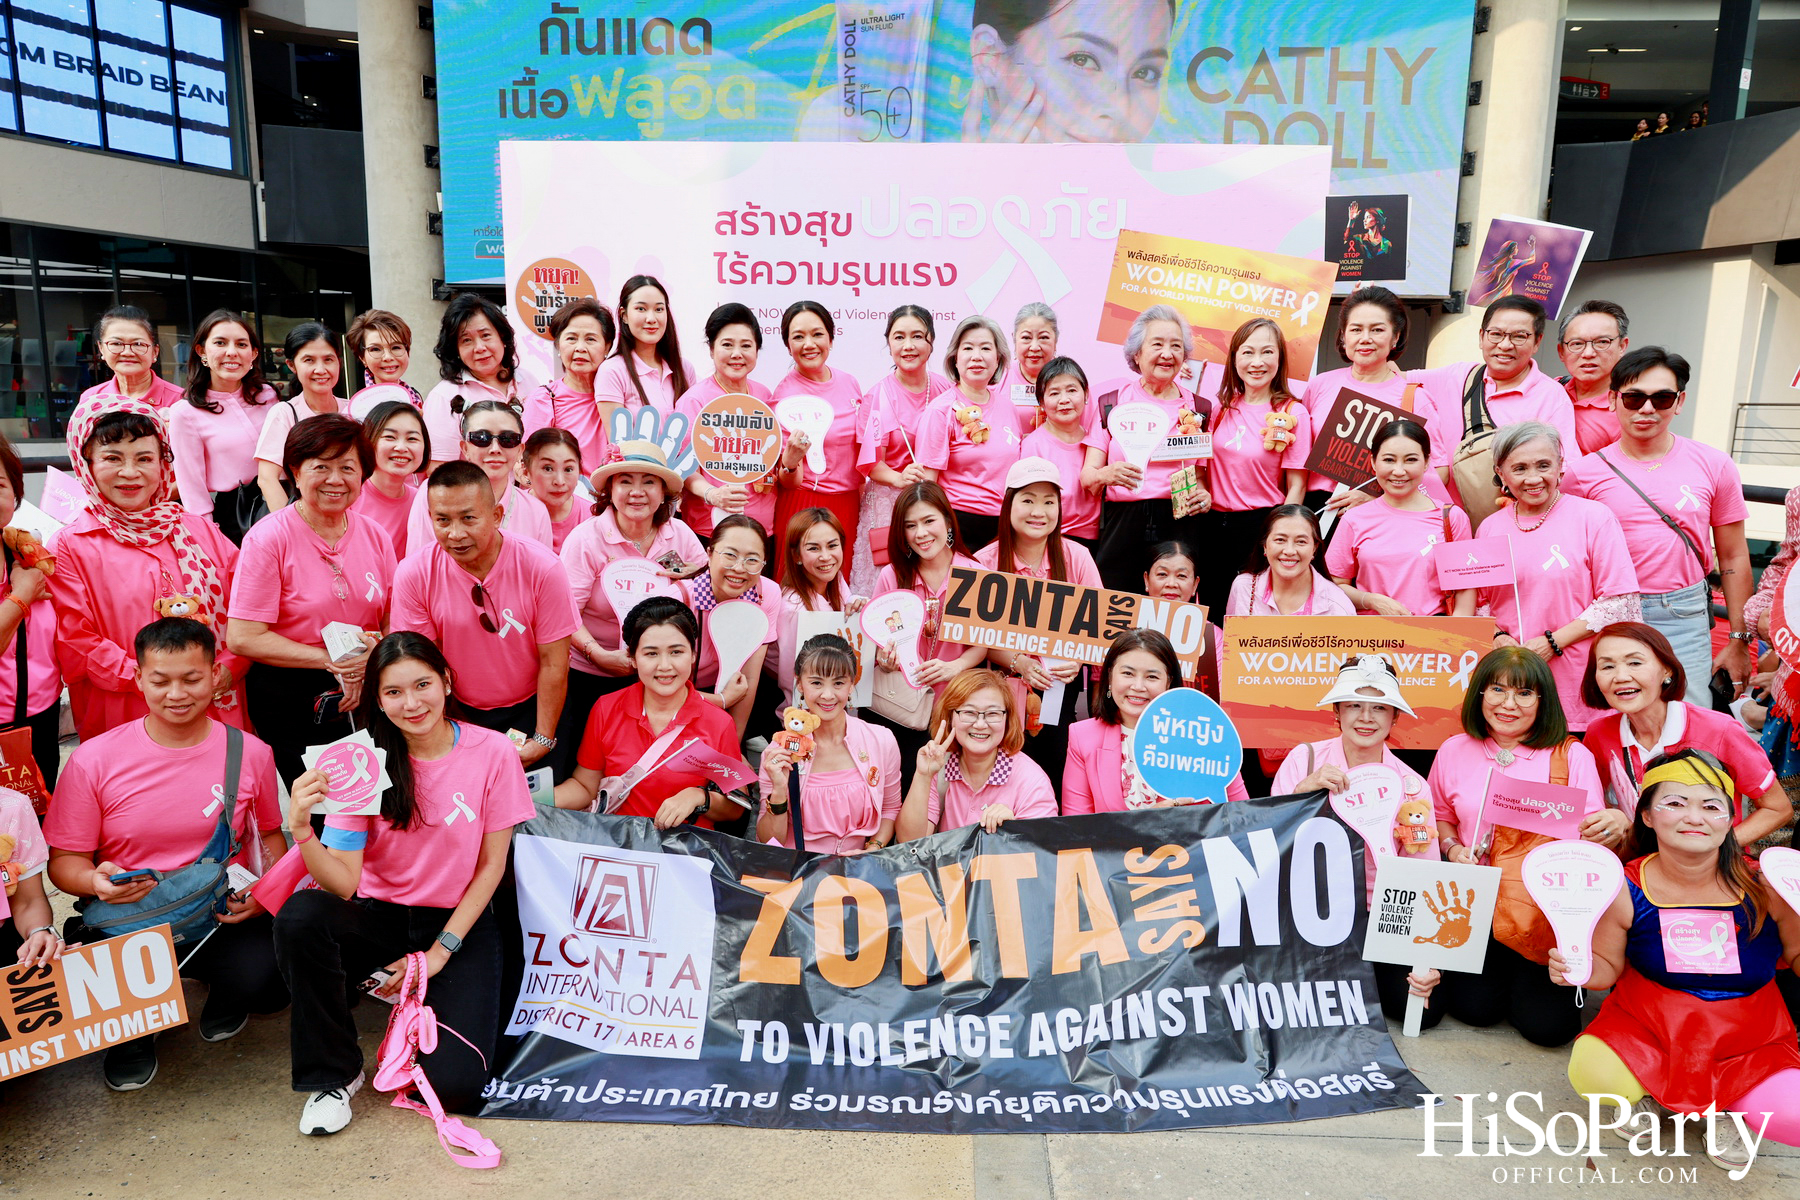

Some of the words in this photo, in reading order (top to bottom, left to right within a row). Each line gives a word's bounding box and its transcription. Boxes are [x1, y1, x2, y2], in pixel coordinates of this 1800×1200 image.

[539, 2, 713, 56] กันแดด
[860, 16, 883, 25] ULTRA
[884, 13, 905, 22] LIGHT
[860, 24, 876, 32] SUN
[877, 22, 894, 31] FLUID
[844, 19, 856, 58] DOLL
[54, 50, 143, 87] BRAID
[1187, 46, 1438, 105] CATHY
[844, 64, 856, 117] CATHY
[714, 201, 853, 248] สร้างสุข
[533, 267, 579, 290] หยุด!
[713, 251, 958, 297] ไร้ความรุนแรง
[1126, 262, 1215, 298] WOMEN
[1215, 278, 1298, 310] POWER
[1525, 280, 1553, 289] VIOLENCE
[1525, 286, 1550, 294] AGAINST
[1532, 273, 1552, 281] STOP
[1121, 282, 1140, 294] FOR
[1139, 286, 1149, 295] A
[1150, 287, 1185, 302] WORLD
[1185, 293, 1233, 311] WITHOUT
[1234, 302, 1281, 319] VIOLENCE
[701, 410, 774, 430] รวมพลัง
[712, 435, 761, 461] หยุด!
[1167, 436, 1194, 447] ZONTA
[1198, 435, 1211, 445] NO
[705, 460, 767, 475] ความรุนแรง
[1318, 458, 1354, 480] AGAINST
[944, 568, 1099, 638] ZONTA
[1103, 593, 1136, 641] SAYS
[943, 621, 963, 642] TO
[969, 625, 1048, 656] VIOLENCE
[1237, 676, 1261, 686] FOR
[1263, 676, 1272, 686] A
[1274, 676, 1317, 686] WORLD
[1152, 707, 1224, 746] ผู้หญิง
[789, 741, 800, 751] NO
[1142, 744, 1230, 777] คือเพศแม่
[739, 847, 1130, 988] ZONTA
[1123, 843, 1206, 955] SAYS
[1202, 816, 1356, 948] NO
[1381, 904, 1414, 916] VIOLENCE
[1383, 888, 1417, 906] STOP
[1377, 923, 1411, 936] WOMEN
[1379, 913, 1412, 925] AGAINST
[527, 931, 702, 991] ZONTA
[7, 960, 63, 1036] SAYS
[61, 931, 174, 1021] NO
[526, 972, 699, 1020] INTERNATIONAL
[73, 999, 180, 1052] WOMEN
[514, 1007, 590, 1033] DISTRICT
[594, 1021, 615, 1041] 17
[625, 1030, 681, 1049] AREA
[683, 1035, 695, 1050] 6
[737, 1019, 790, 1063] TO
[803, 1011, 1014, 1067] VIOLENCE
[1028, 985, 1210, 1058] AGAINST
[1221, 980, 1369, 1033] WOMEN
